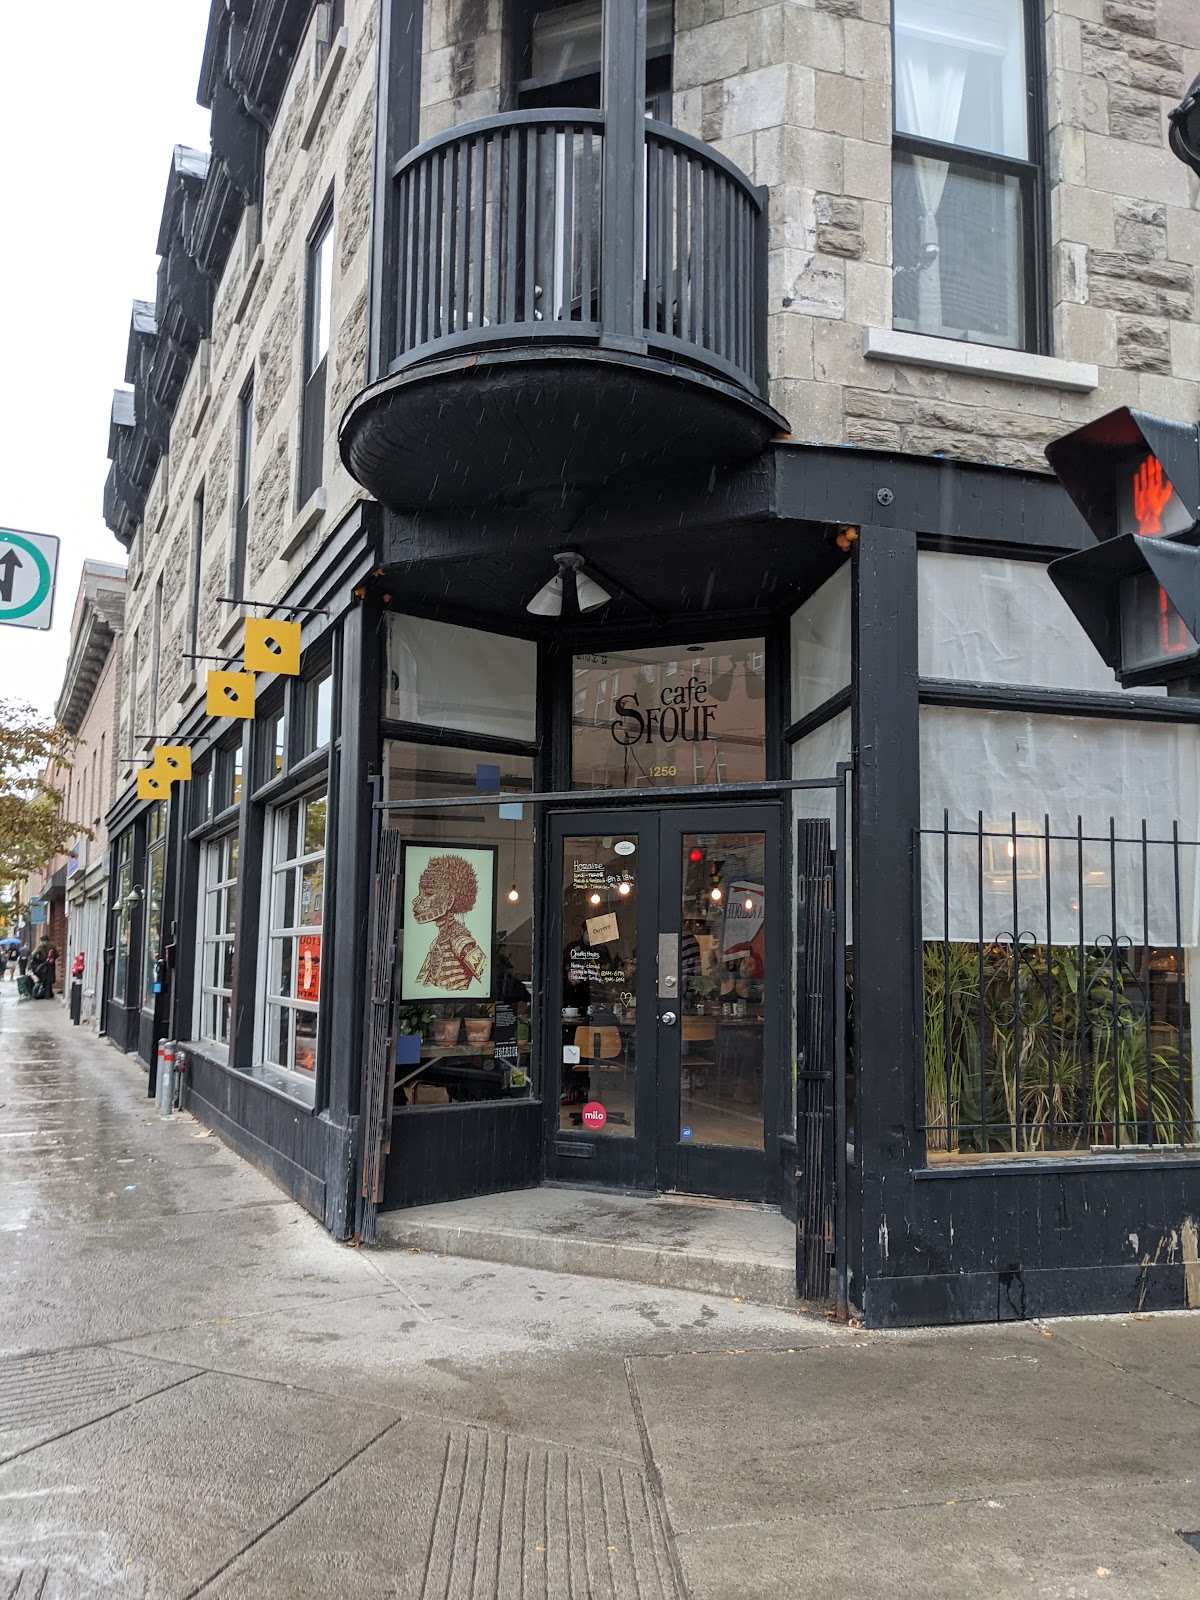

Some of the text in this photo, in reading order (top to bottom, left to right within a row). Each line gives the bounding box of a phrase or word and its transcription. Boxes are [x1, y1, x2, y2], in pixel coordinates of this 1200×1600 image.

[660, 676, 707, 712] café
[611, 692, 718, 746] SFOUF
[648, 765, 677, 777] 1250
[585, 1110, 604, 1120] milo
